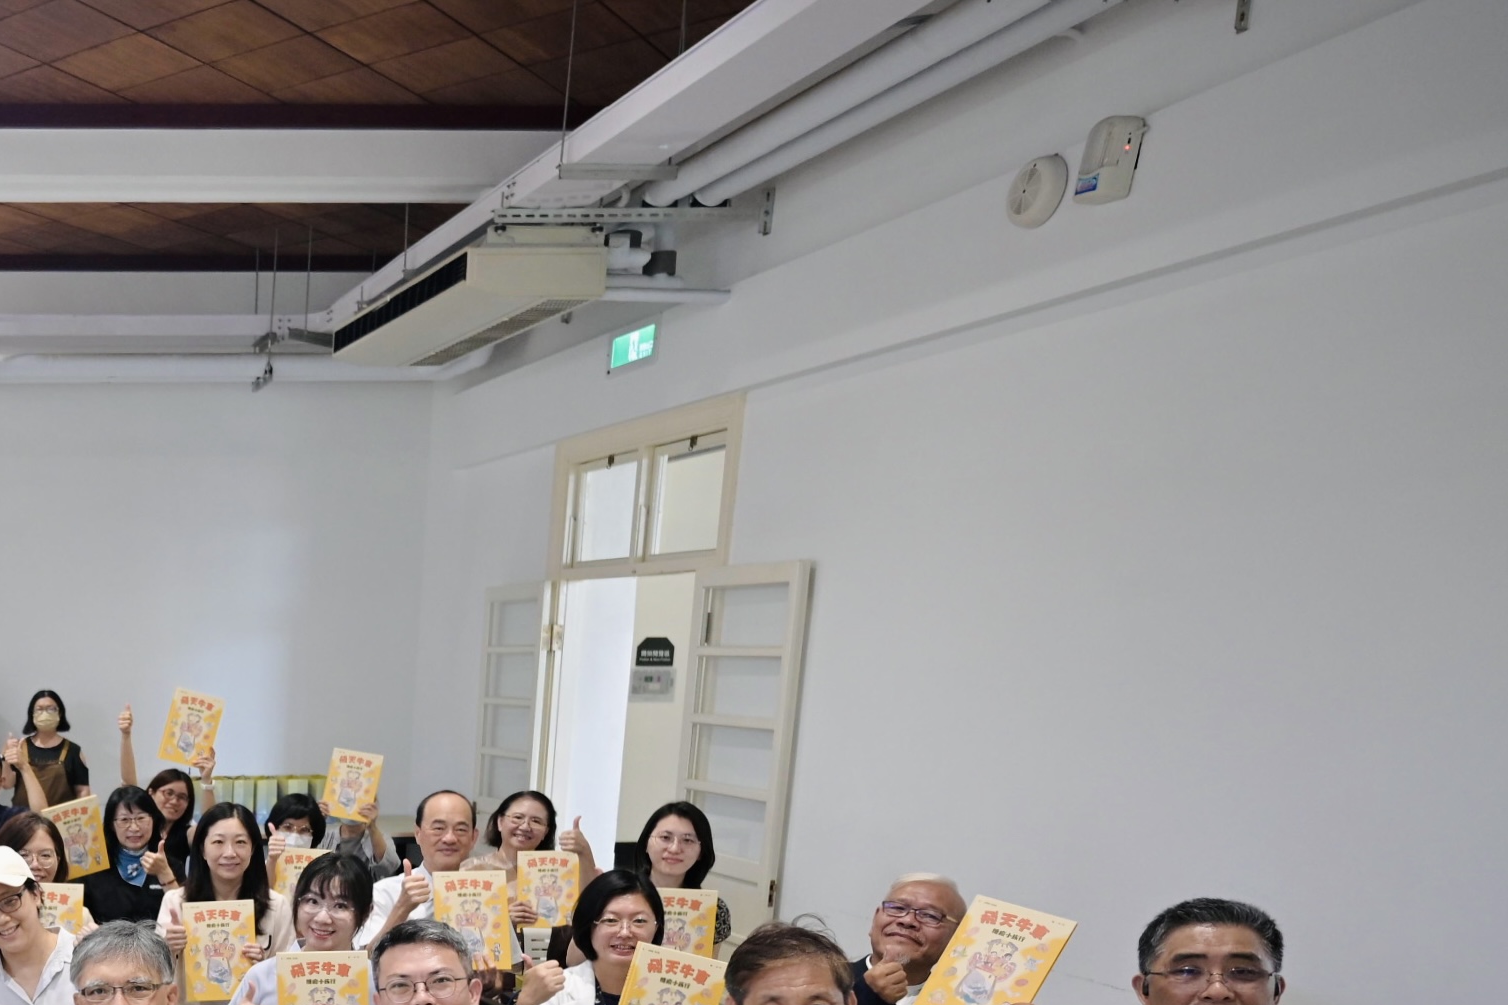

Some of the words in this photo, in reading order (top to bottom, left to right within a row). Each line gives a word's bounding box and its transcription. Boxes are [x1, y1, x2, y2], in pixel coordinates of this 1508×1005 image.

[444, 878, 493, 893] 飛天牛車
[194, 909, 241, 923] 飛天牛車
[980, 910, 1050, 940] 飛天牛車
[290, 961, 351, 978] 飛天牛車
[647, 958, 711, 985] 飛天牛車
